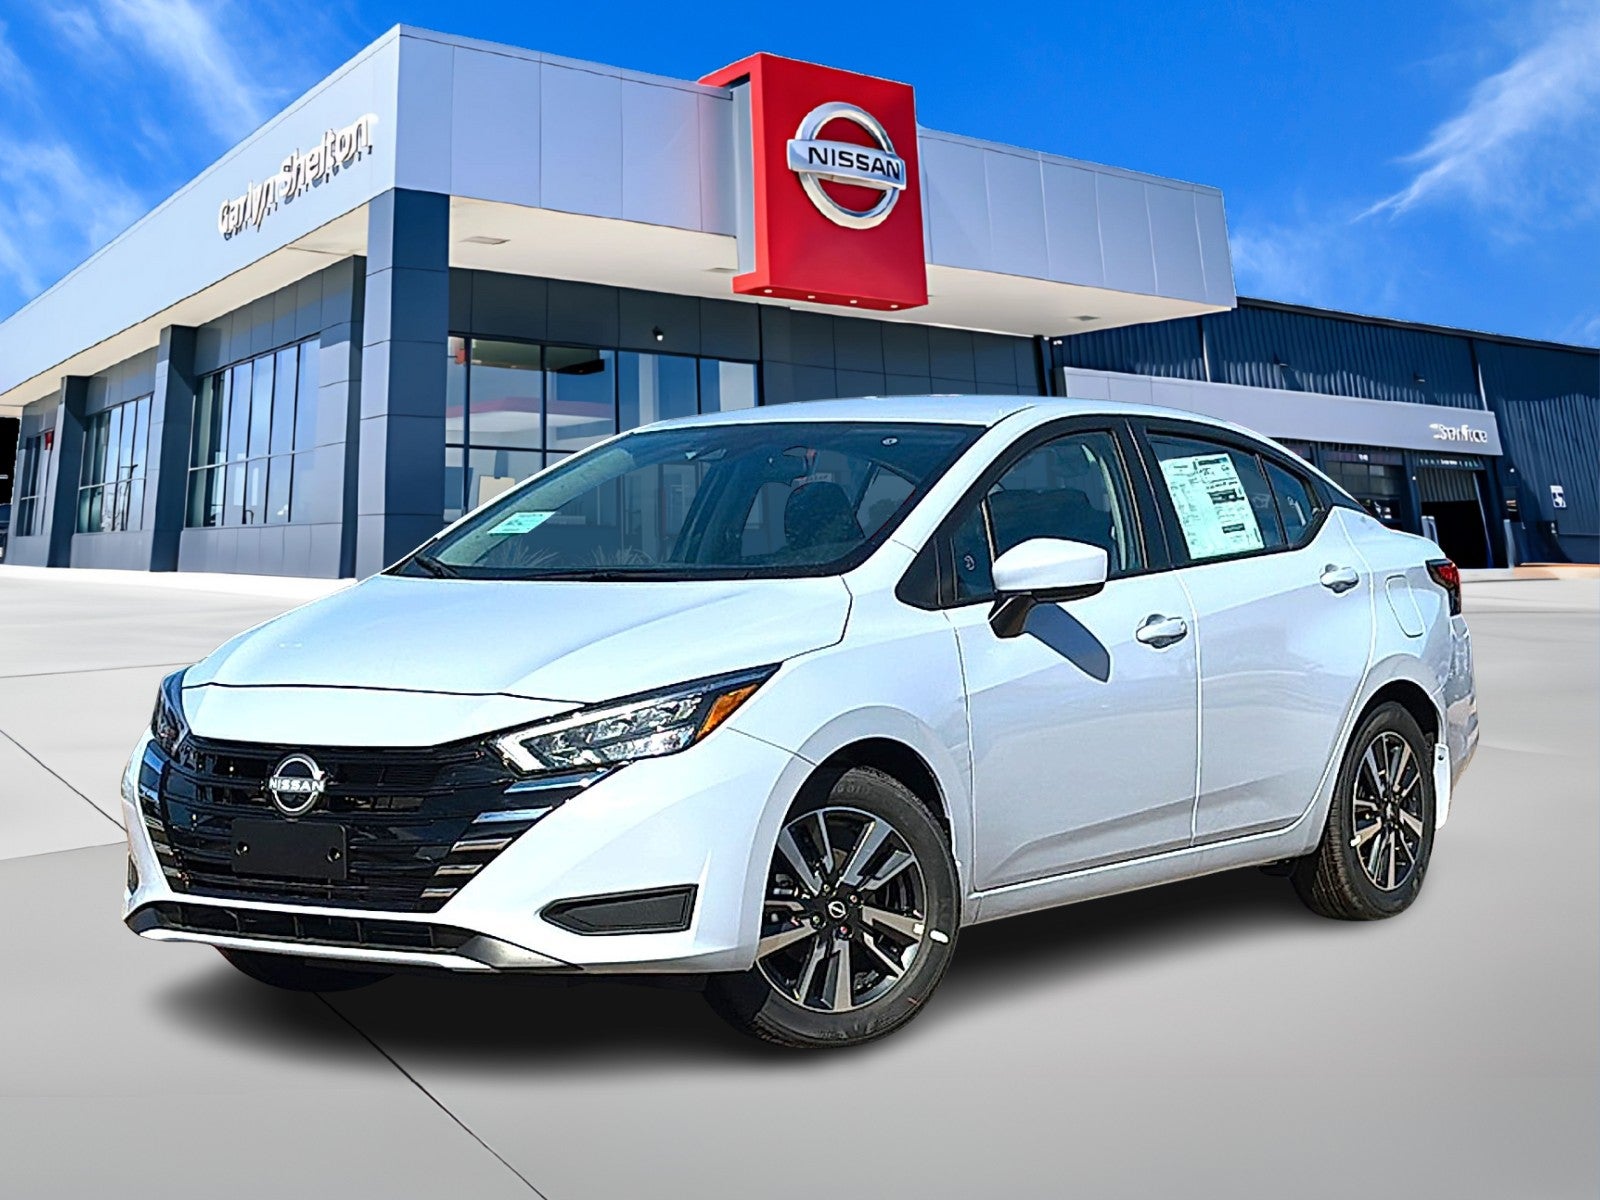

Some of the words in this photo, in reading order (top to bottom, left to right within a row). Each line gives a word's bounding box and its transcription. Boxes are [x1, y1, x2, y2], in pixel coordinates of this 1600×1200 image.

[279, 116, 376, 201] Shelton
[808, 146, 900, 180] NISSAN
[269, 777, 325, 793] NISSAN
